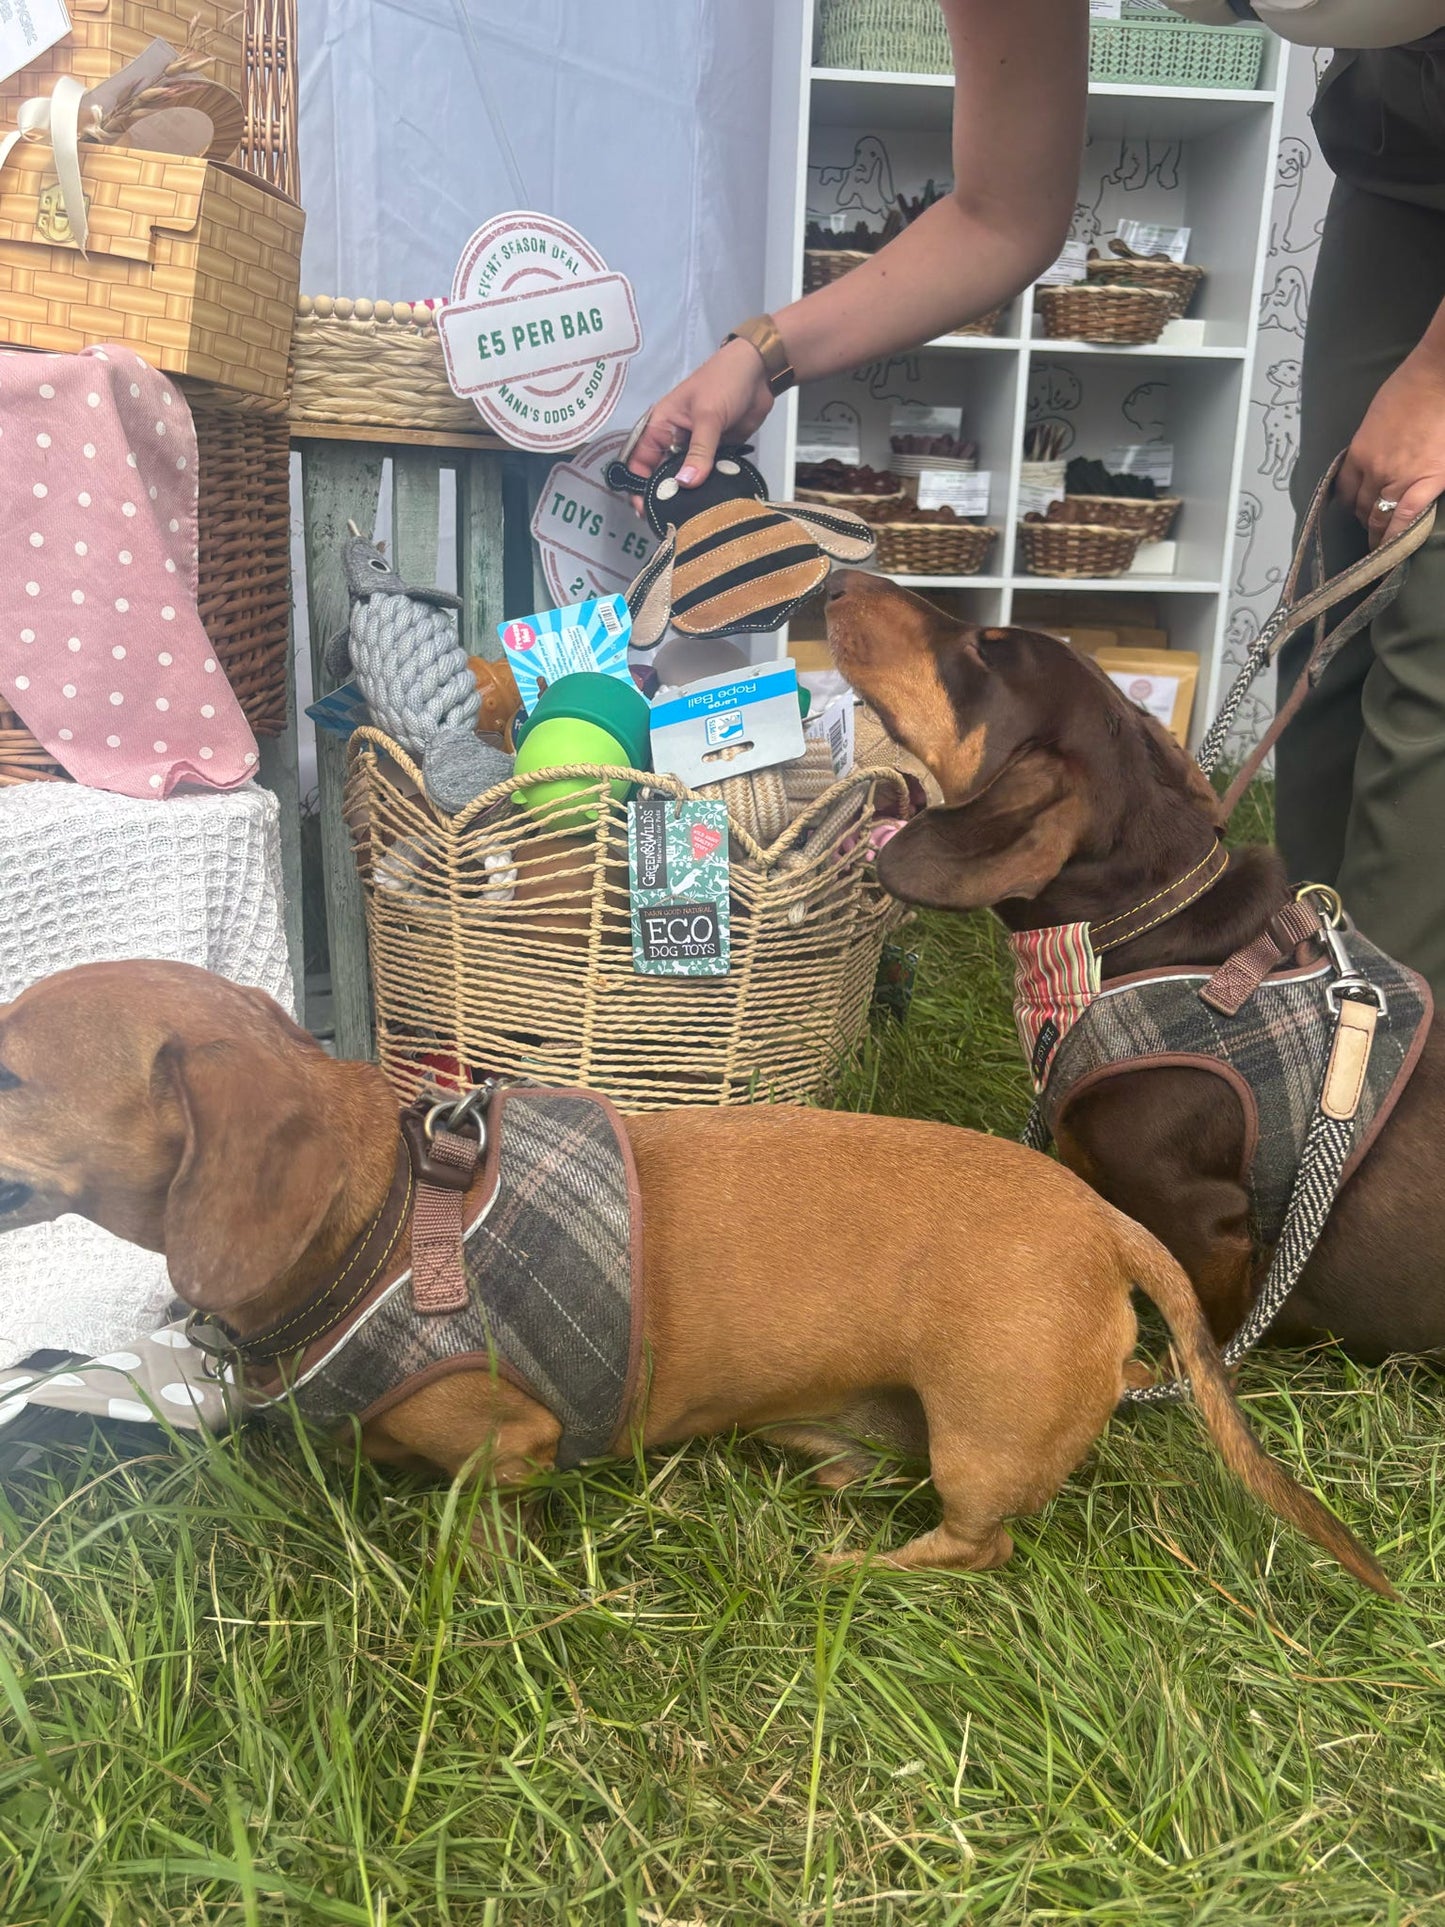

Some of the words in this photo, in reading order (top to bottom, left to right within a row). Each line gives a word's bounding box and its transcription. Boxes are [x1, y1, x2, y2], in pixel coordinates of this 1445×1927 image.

[478, 254, 503, 298] EVENT
[501, 237, 547, 260] SEASON
[551, 244, 580, 276] DEAL
[477, 330, 506, 360] £5
[512, 319, 556, 351] PER
[560, 307, 604, 340] BAG
[498, 384, 540, 422] NANA'S
[544, 405, 576, 424] ODDS
[577, 397, 587, 410] &
[586, 360, 606, 397] SODS
[551, 492, 604, 536] TOYS
[621, 532, 649, 559] £5
[688, 693, 713, 709] Ball
[718, 682, 757, 699] Rope
[707, 696, 738, 710] Large
[683, 905, 713, 916] NATURAL
[645, 916, 714, 945] ECO
[649, 945, 678, 958] DOG
[682, 944, 716, 955] TOYS
